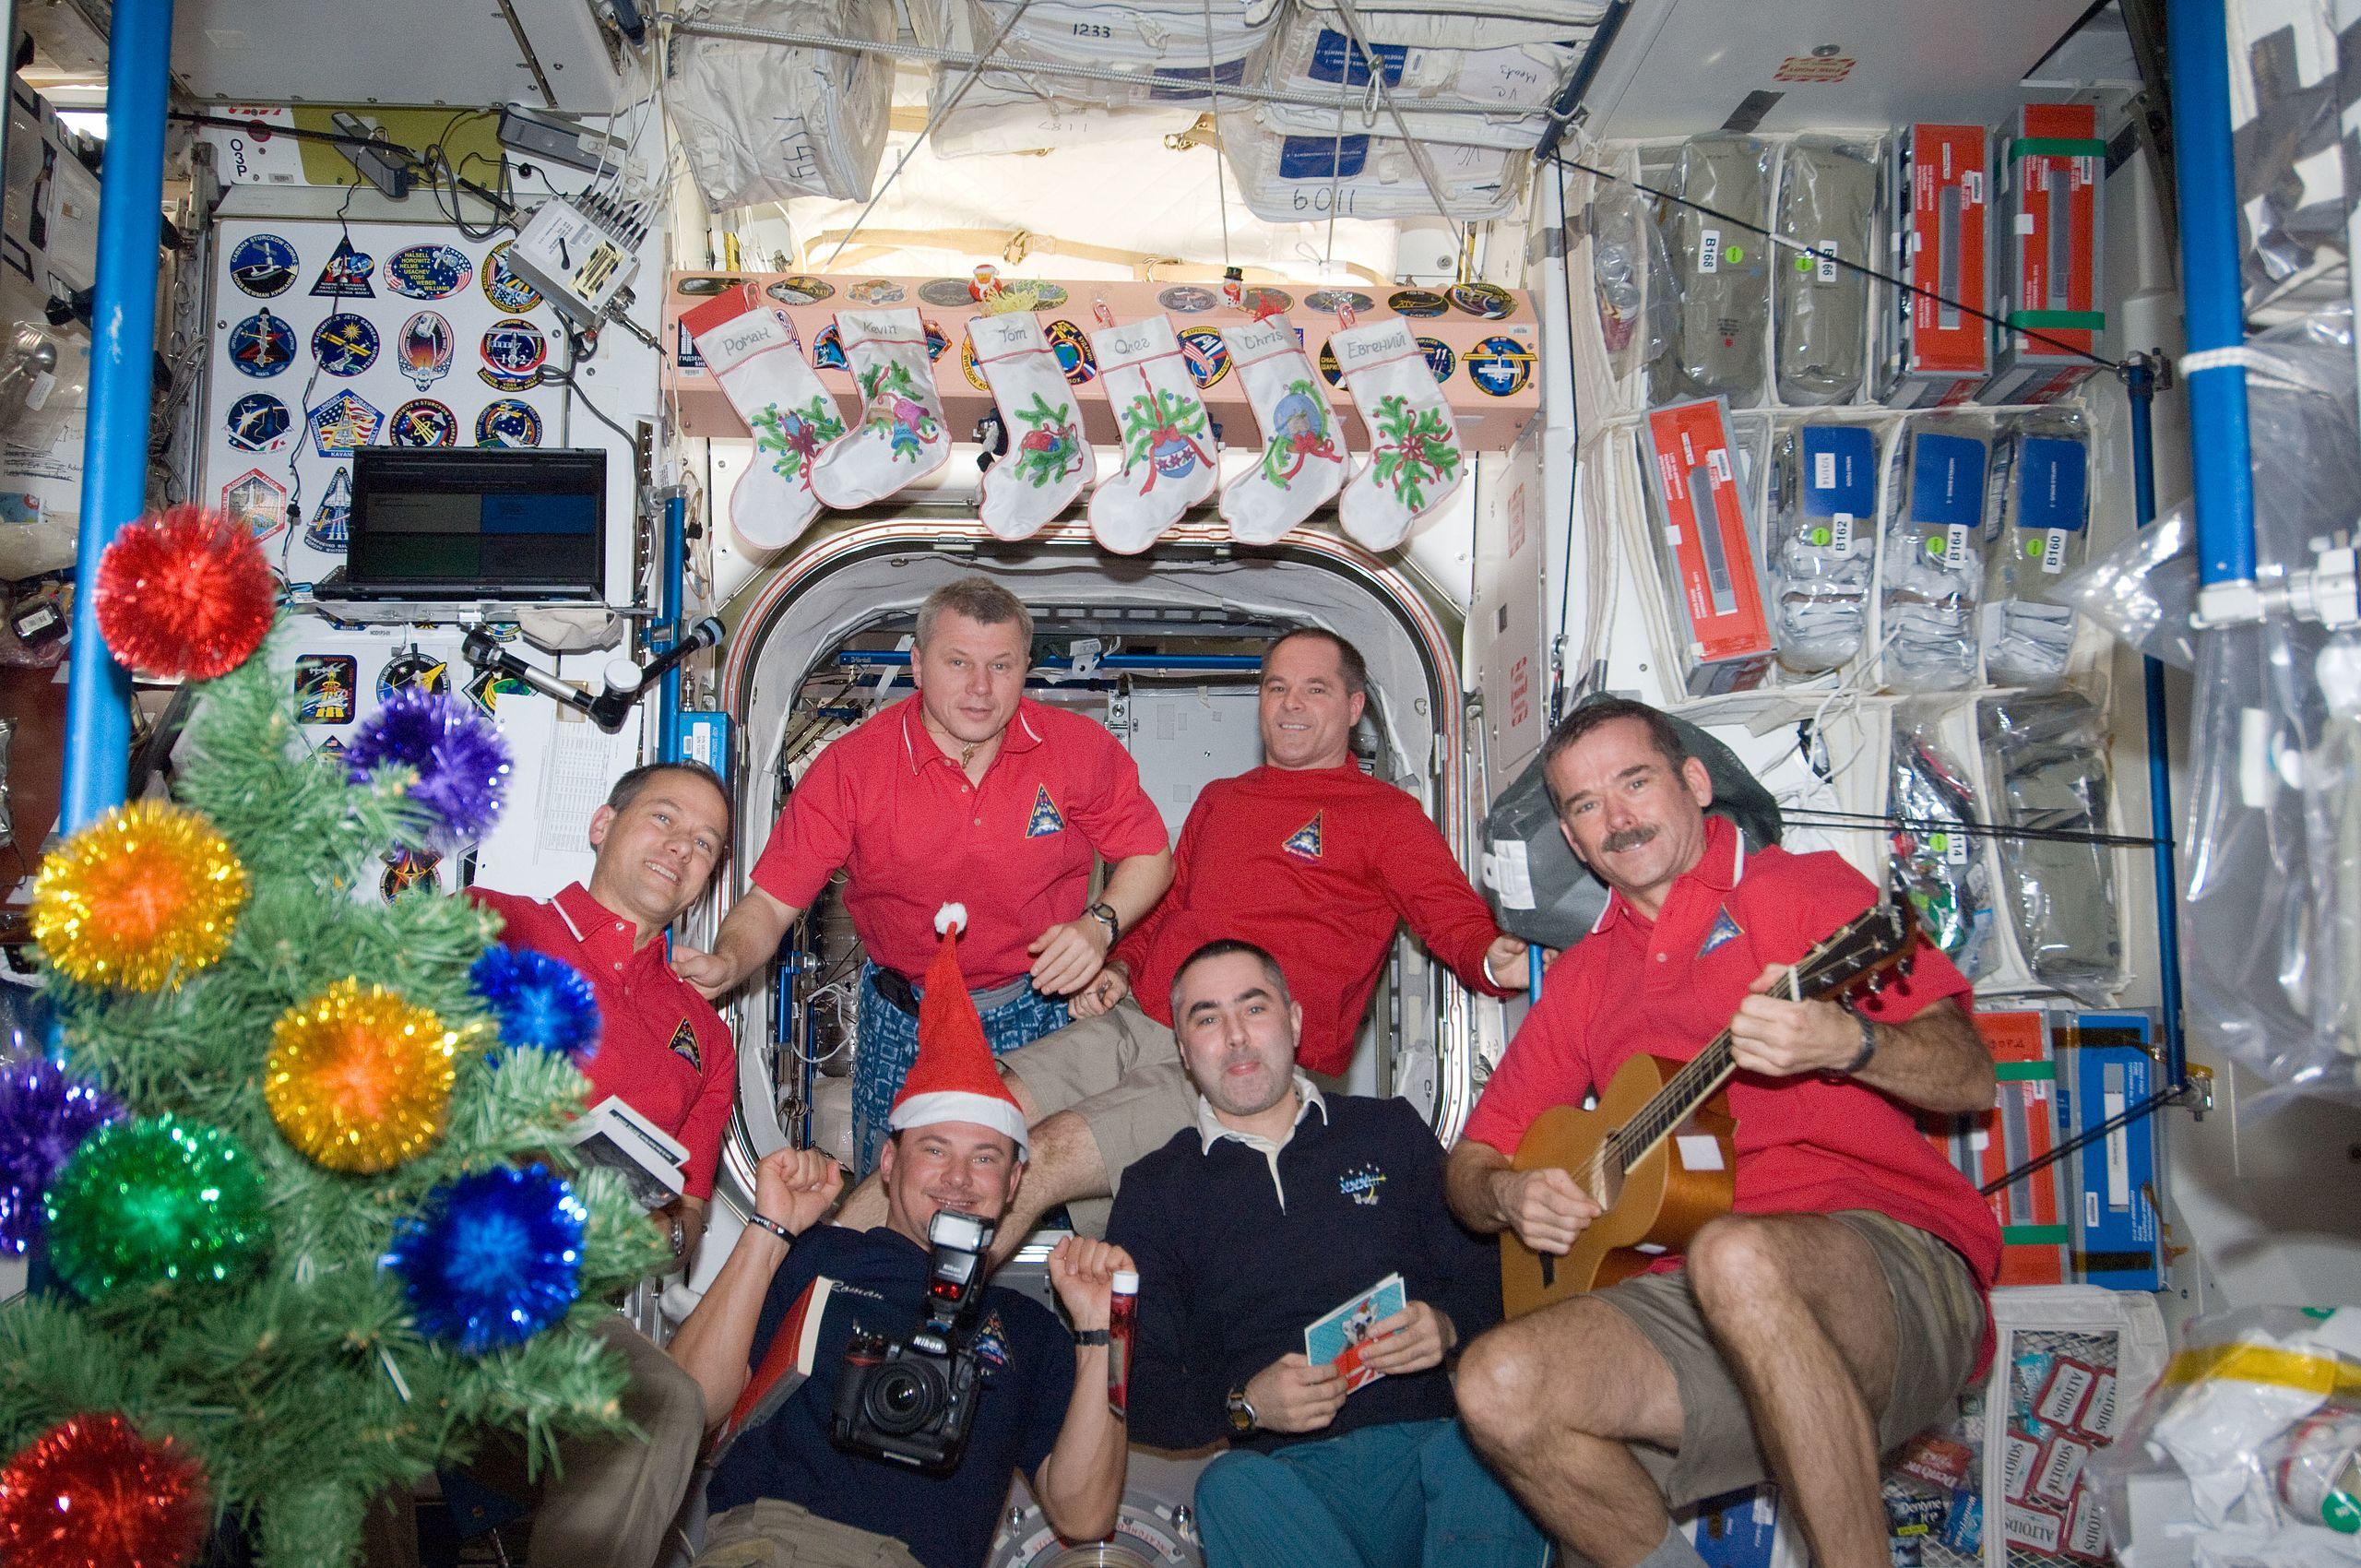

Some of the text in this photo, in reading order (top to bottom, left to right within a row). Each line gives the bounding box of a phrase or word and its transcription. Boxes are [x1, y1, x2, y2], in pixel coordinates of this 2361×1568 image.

[1074, 23, 1110, 38] 1233
[1499, 65, 1536, 83] Meats
[232, 242, 249, 263] CABANA
[250, 235, 283, 245] STURCKOW
[1703, 238, 1716, 267] B168
[232, 274, 244, 289] ROSS
[243, 287, 270, 298] NEWMAN
[314, 315, 340, 343] BLOOMFILD
[863, 322, 899, 335] Kevin
[998, 325, 1027, 341] Tom
[1078, 336, 1094, 362] БУДАРИН
[1244, 331, 1284, 350] Chris
[1347, 332, 1407, 360] Евгений
[1436, 348, 1448, 360] 11
[964, 354, 979, 384] WHITSON
[319, 395, 341, 411] LINDSEY
[352, 395, 377, 415] HOBAUGH
[393, 400, 450, 426] HOROWITZ STURCKOW
[479, 407, 492, 422] GORIE
[528, 407, 539, 422] KELLY
[367, 426, 380, 445] REILLY
[1821, 457, 1830, 485] 1/31/14
[1834, 519, 1849, 552] B162
[1951, 530, 1964, 563] B164
[2047, 535, 2060, 567] B160
[322, 568, 339, 585] LINDSEY
[943, 1263, 962, 1273] Nikon
[831, 1279, 884, 1300] Roman
[913, 1336, 942, 1351] Nikon
[2053, 1372, 2083, 1419] ALTOIDS
[2047, 1445, 2074, 1495] ALTOIDS
[1896, 1500, 1942, 1517] Dentyne
[2005, 1516, 2055, 1542] ALTOIDS
